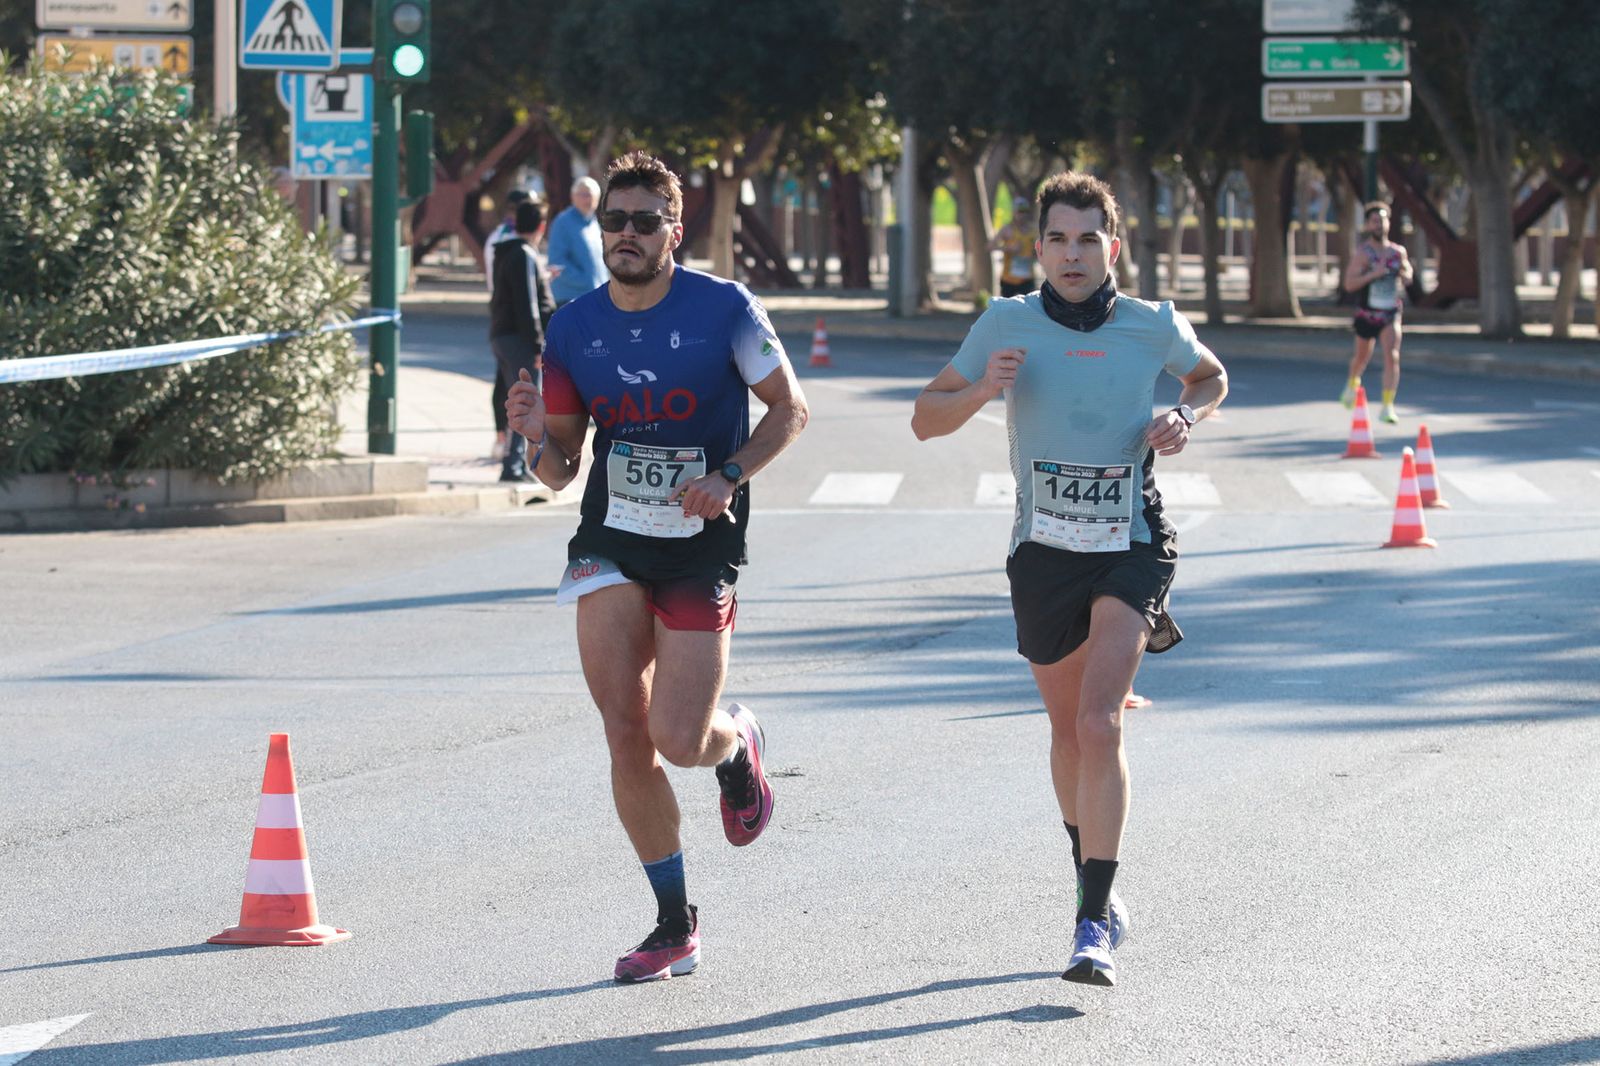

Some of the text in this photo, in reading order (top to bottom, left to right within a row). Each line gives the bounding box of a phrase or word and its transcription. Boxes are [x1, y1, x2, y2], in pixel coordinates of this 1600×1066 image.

[591, 387, 697, 429] GALO
[653, 452, 667, 460] 2022
[626, 460, 685, 488] 567
[640, 487, 666, 496] LUCAS
[1045, 476, 1122, 505] 1444
[1063, 504, 1098, 514] SAMUEL
[571, 563, 600, 581] GALO
